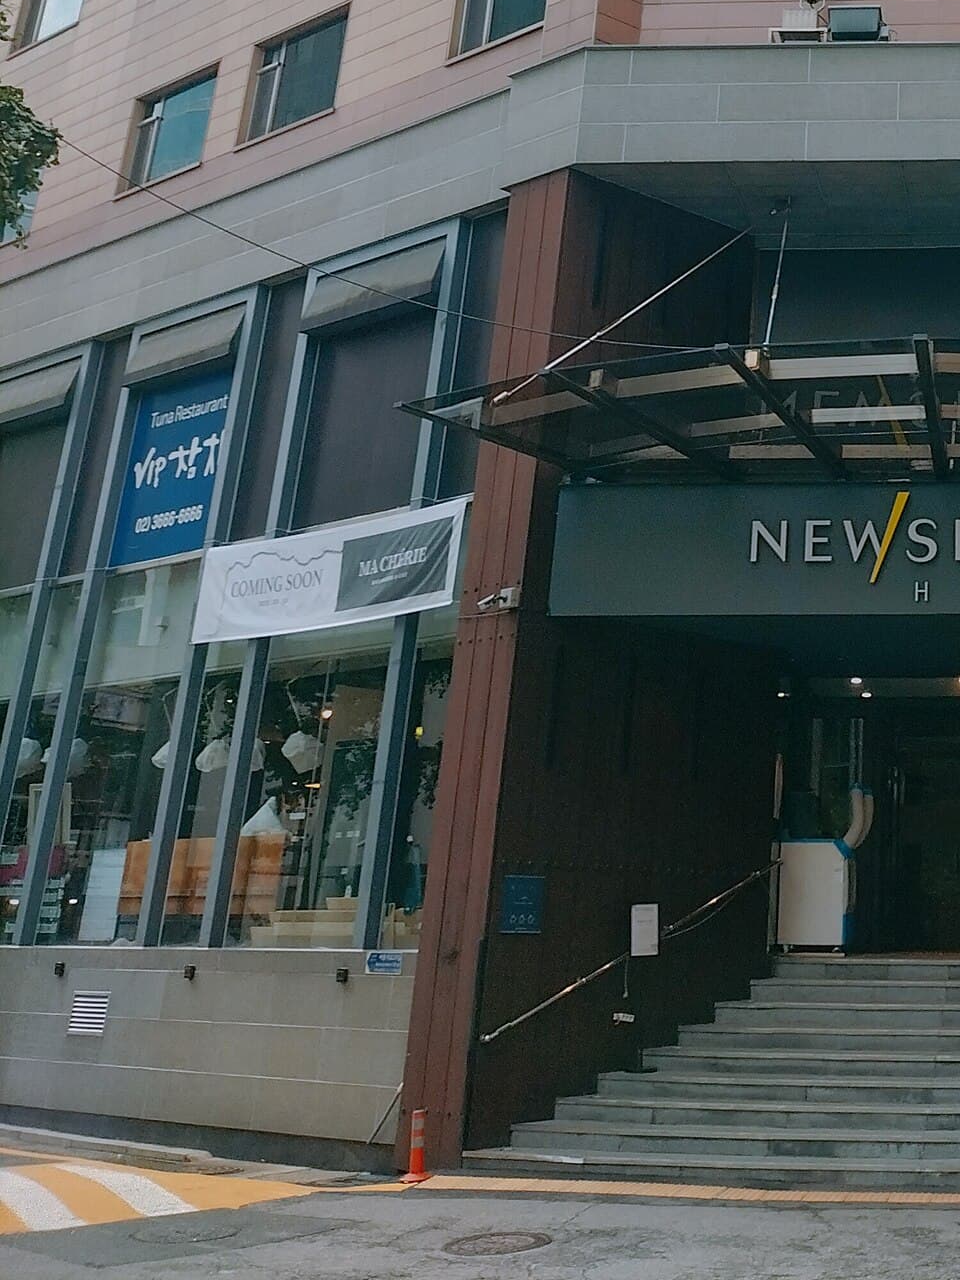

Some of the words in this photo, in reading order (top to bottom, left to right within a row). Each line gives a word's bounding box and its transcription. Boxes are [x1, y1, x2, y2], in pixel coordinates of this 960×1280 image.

[151, 411, 175, 429] Tuna
[174, 395, 229, 422] Restaurant
[358, 559, 379, 577] MA
[379, 545, 428, 571] CHÉRIE
[230, 575, 283, 599] COMING
[284, 569, 322, 592] SOON
